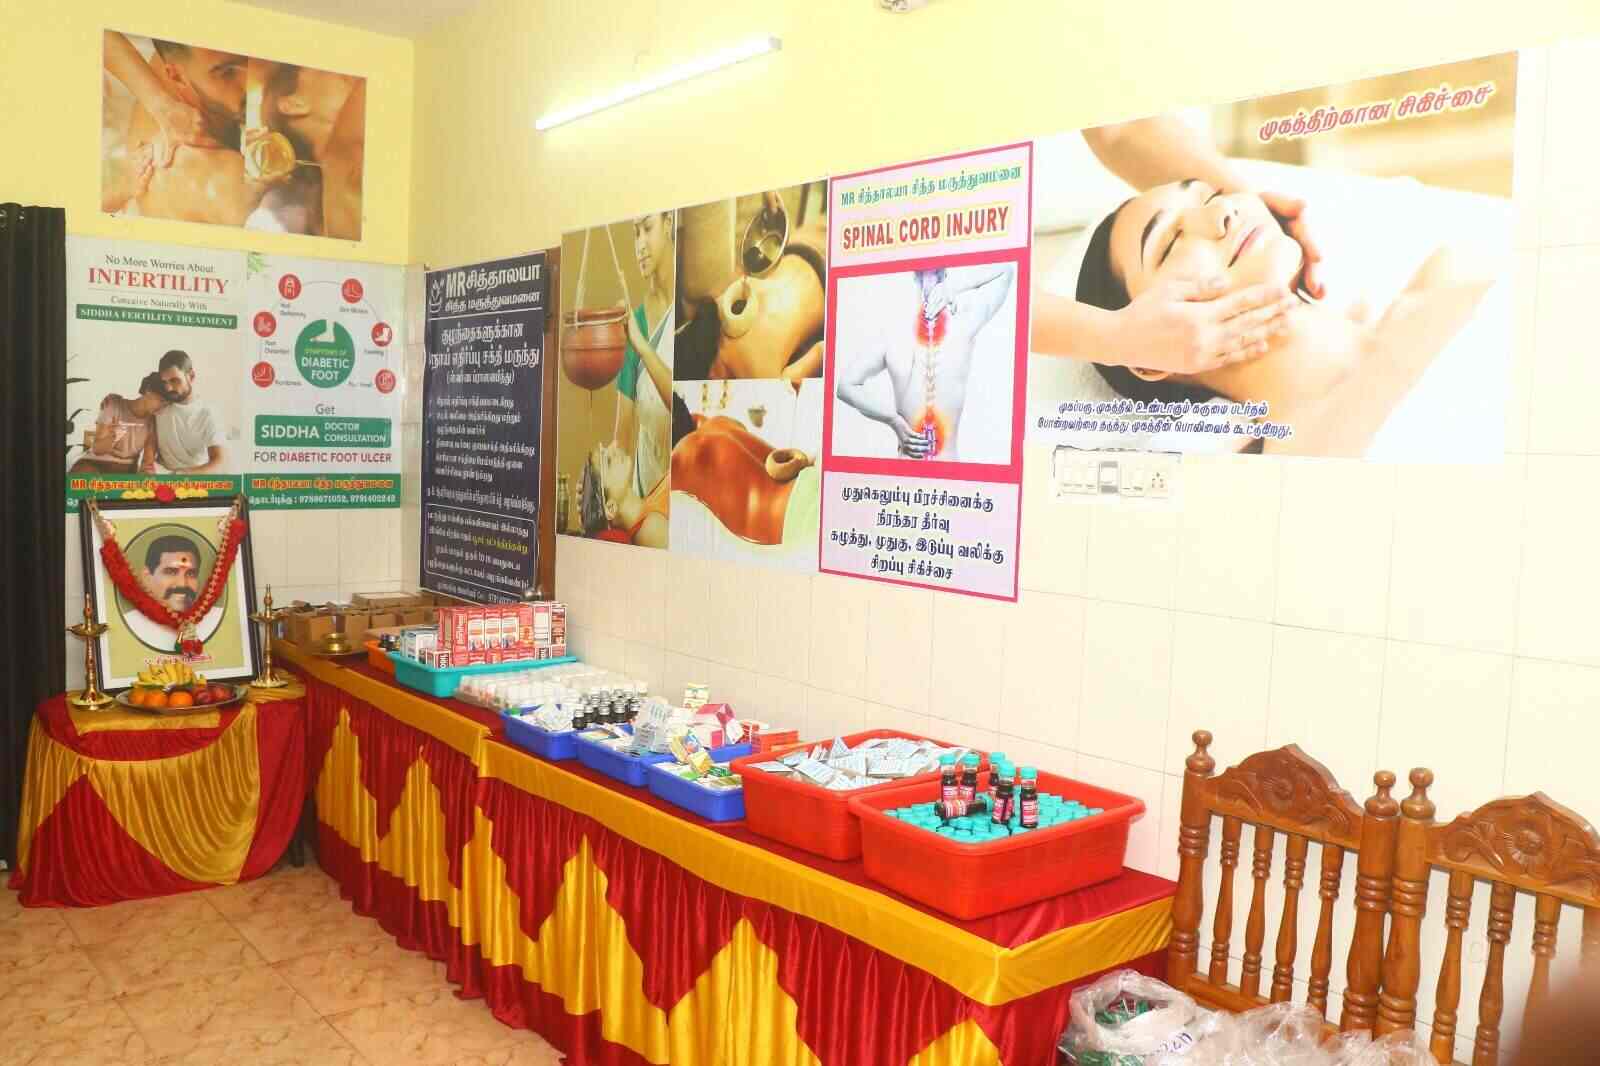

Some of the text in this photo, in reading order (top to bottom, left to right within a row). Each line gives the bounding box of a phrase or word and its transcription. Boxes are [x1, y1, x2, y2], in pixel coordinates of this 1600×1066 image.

[1259, 86, 1494, 141] முகத்திற்கான சிகிச்சை
[841, 192, 855, 206] MR
[843, 206, 1008, 249] SPINAL CORD INJURY
[105, 254, 215, 273] No More Worries About
[88, 267, 228, 295] INFERTILITY
[189, 301, 208, 311] With
[80, 309, 233, 327] SIDDHA FERTILITY TREATMENT
[302, 357, 350, 368] DIABETIC
[504, 342, 539, 368] மருந்து
[311, 370, 339, 380] FOOT
[315, 403, 335, 415] Get
[261, 422, 360, 438] SIDDHA DOCTOR
[324, 433, 386, 442] CONSULTATION
[254, 451, 392, 463] FOR DIABETIC FOOT ULCER
[841, 486, 911, 506] முதுகெலும்பு
[877, 509, 950, 533] நிரந்தர தீர்வு
[915, 537, 954, 559] இடுப்பு
[958, 542, 1004, 564] வலிக்கு
[870, 554, 953, 580] சிறப்பு சிகிச்சை
